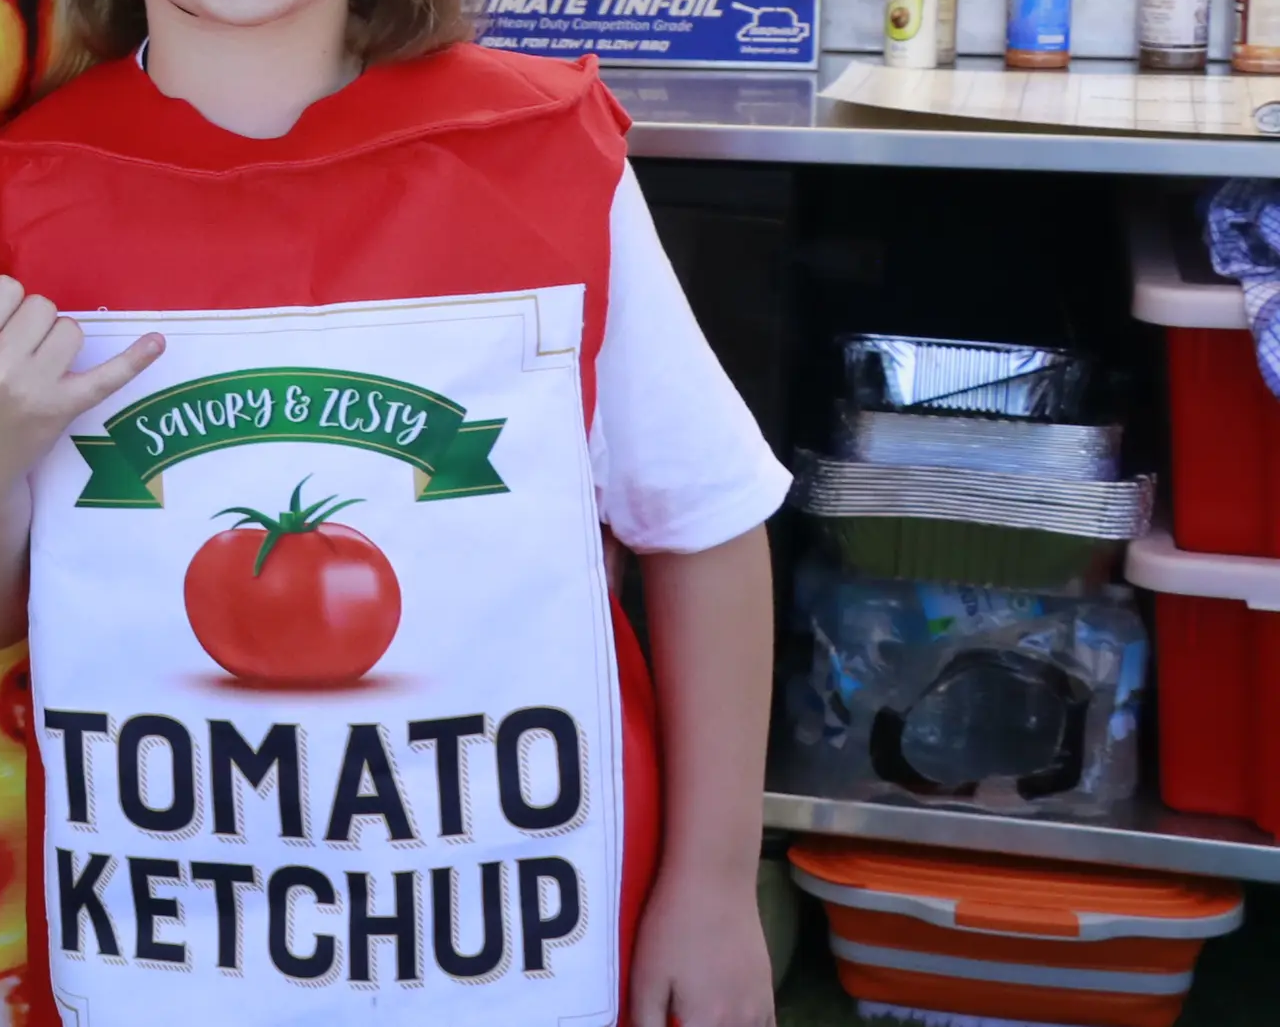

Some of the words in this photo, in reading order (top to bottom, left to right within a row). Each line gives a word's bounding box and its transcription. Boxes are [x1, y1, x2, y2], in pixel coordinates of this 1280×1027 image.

[480, 36, 519, 48] IDEAL
[520, 37, 550, 49] FOR
[550, 38, 582, 50] LOW
[595, 39, 637, 51] SLOW
[497, 17, 537, 32] Heavy
[540, 17, 570, 32] Duty
[573, 18, 650, 32] Competition
[653, 20, 693, 32] Grade
[284, 385, 312, 423] &
[44, 705, 588, 849] TOMATO
[55, 846, 588, 992] KETCHUP
